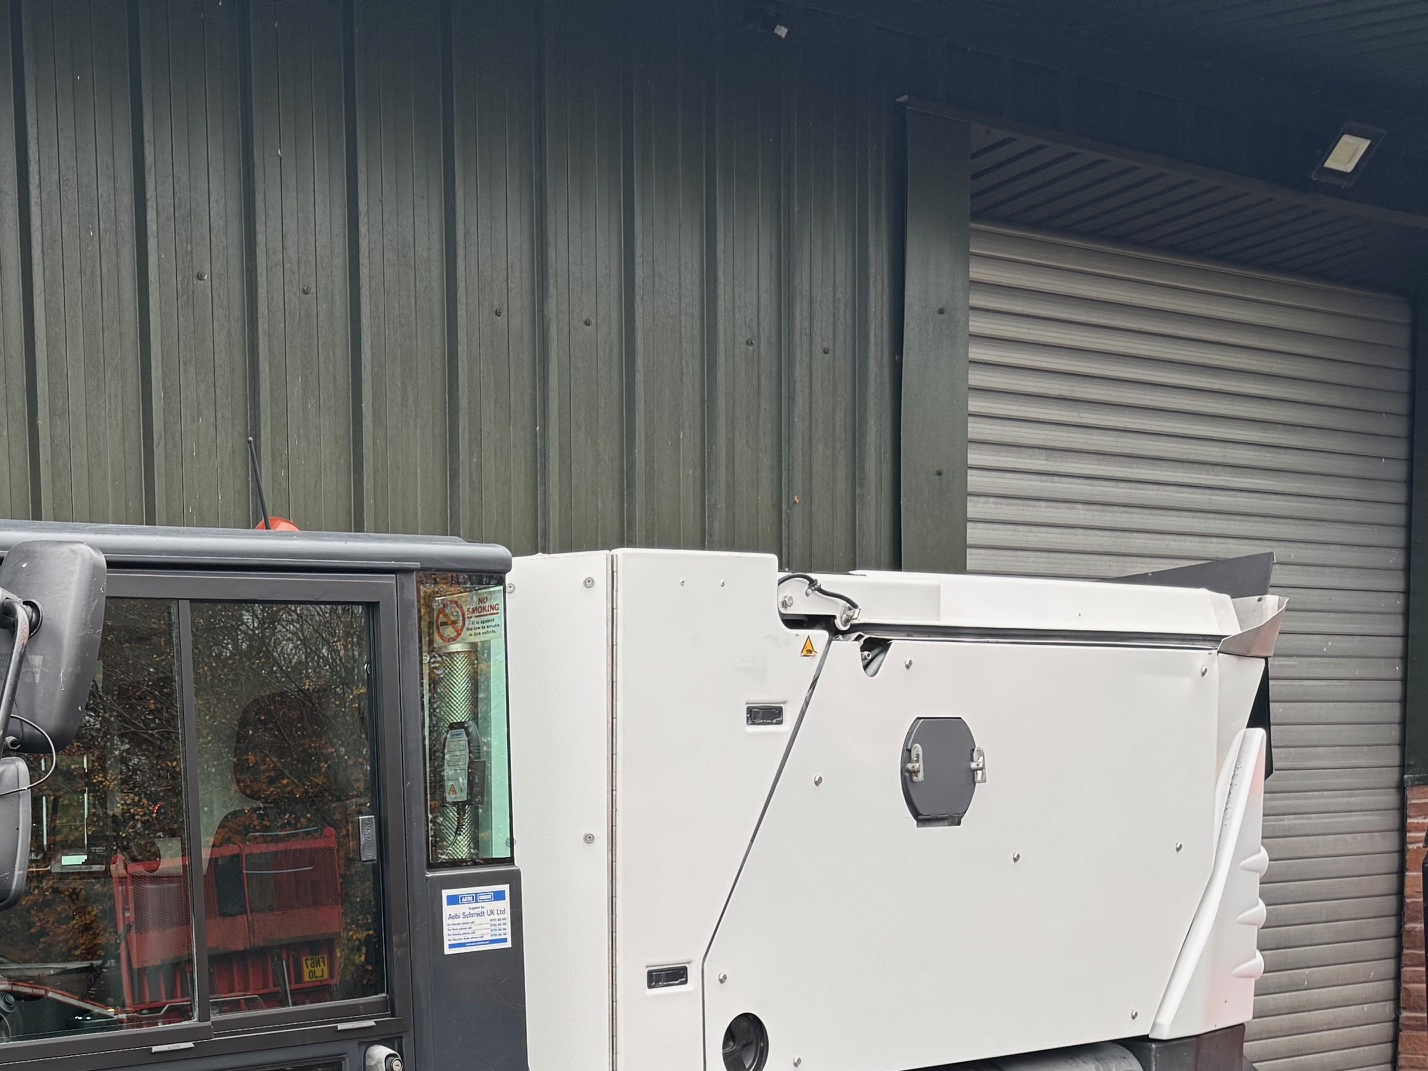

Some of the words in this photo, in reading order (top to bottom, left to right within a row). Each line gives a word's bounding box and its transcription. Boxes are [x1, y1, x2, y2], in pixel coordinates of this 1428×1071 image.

[478, 596, 488, 605] NO
[467, 603, 499, 614] SMOKING
[448, 912, 461, 920] Aebi
[462, 911, 485, 919] Schmidt
